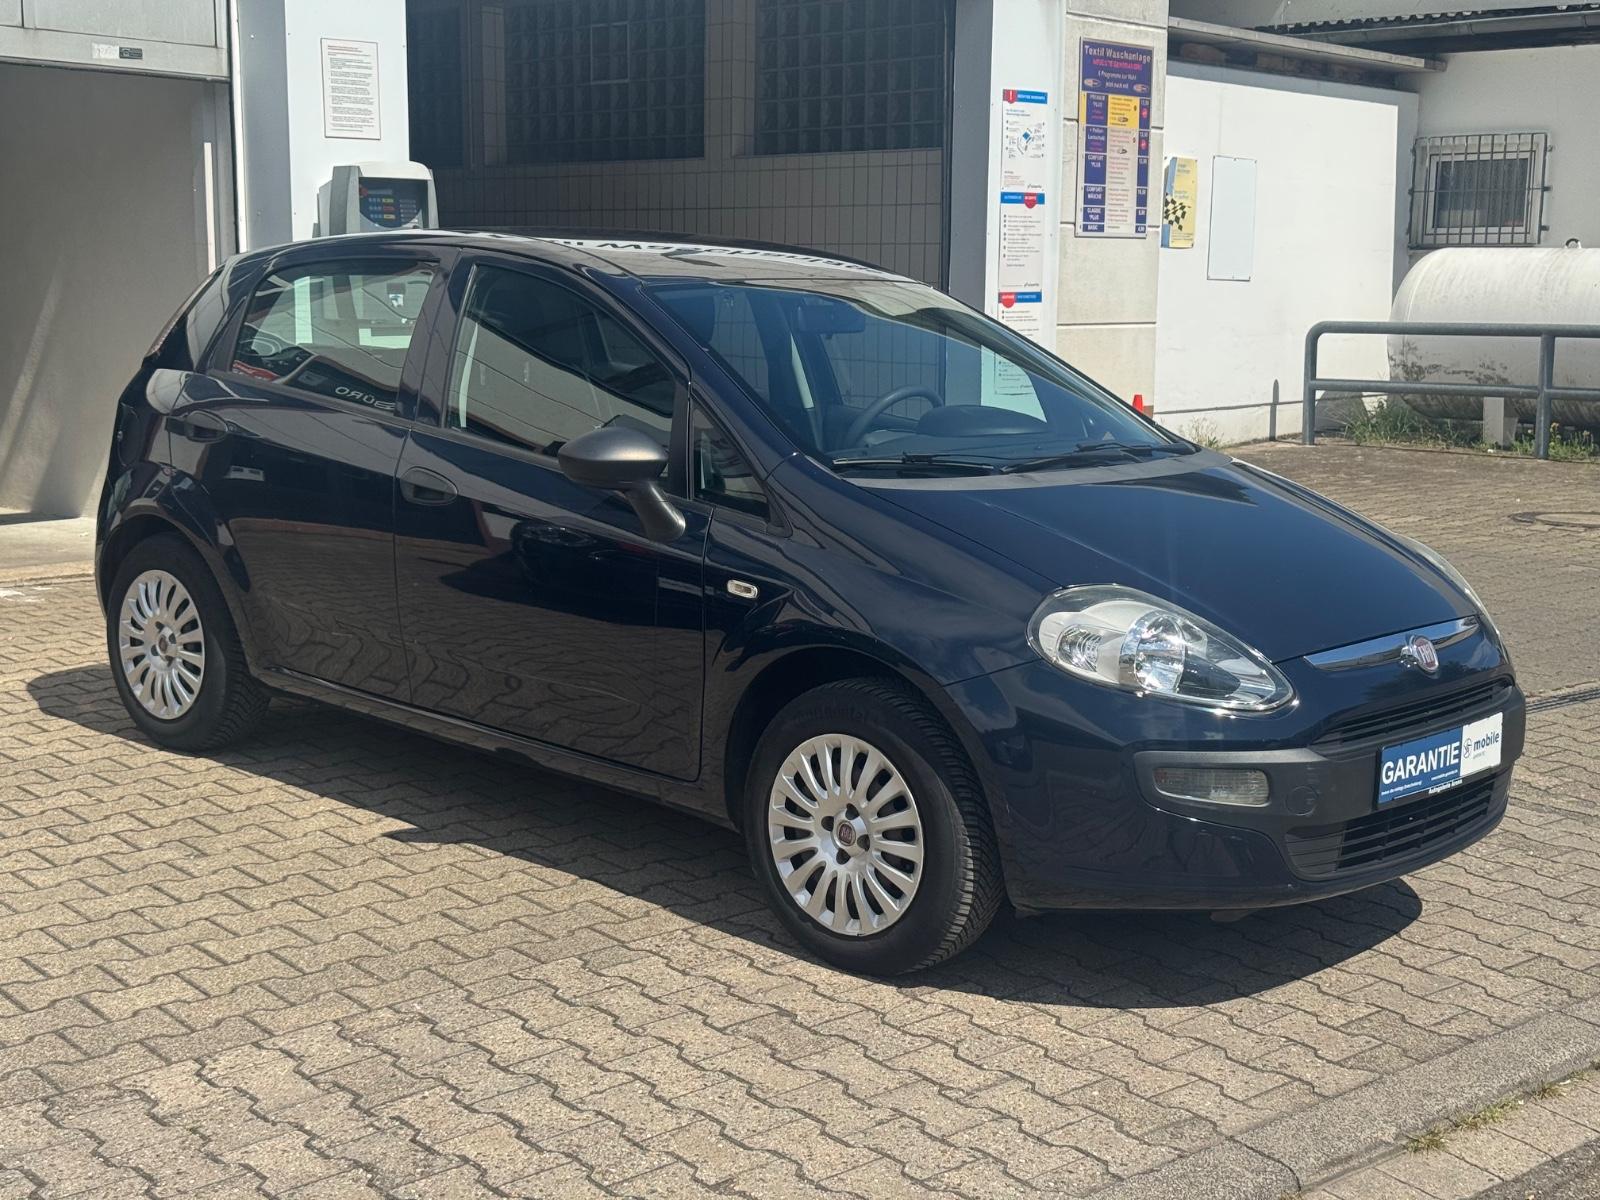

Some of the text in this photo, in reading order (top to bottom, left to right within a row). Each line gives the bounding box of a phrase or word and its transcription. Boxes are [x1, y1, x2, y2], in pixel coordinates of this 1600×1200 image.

[1084, 45, 1104, 56] Textil
[1105, 48, 1151, 64] Waschanlage
[1473, 731, 1500, 751] mobile
[1382, 741, 1460, 785] GARANTIE
